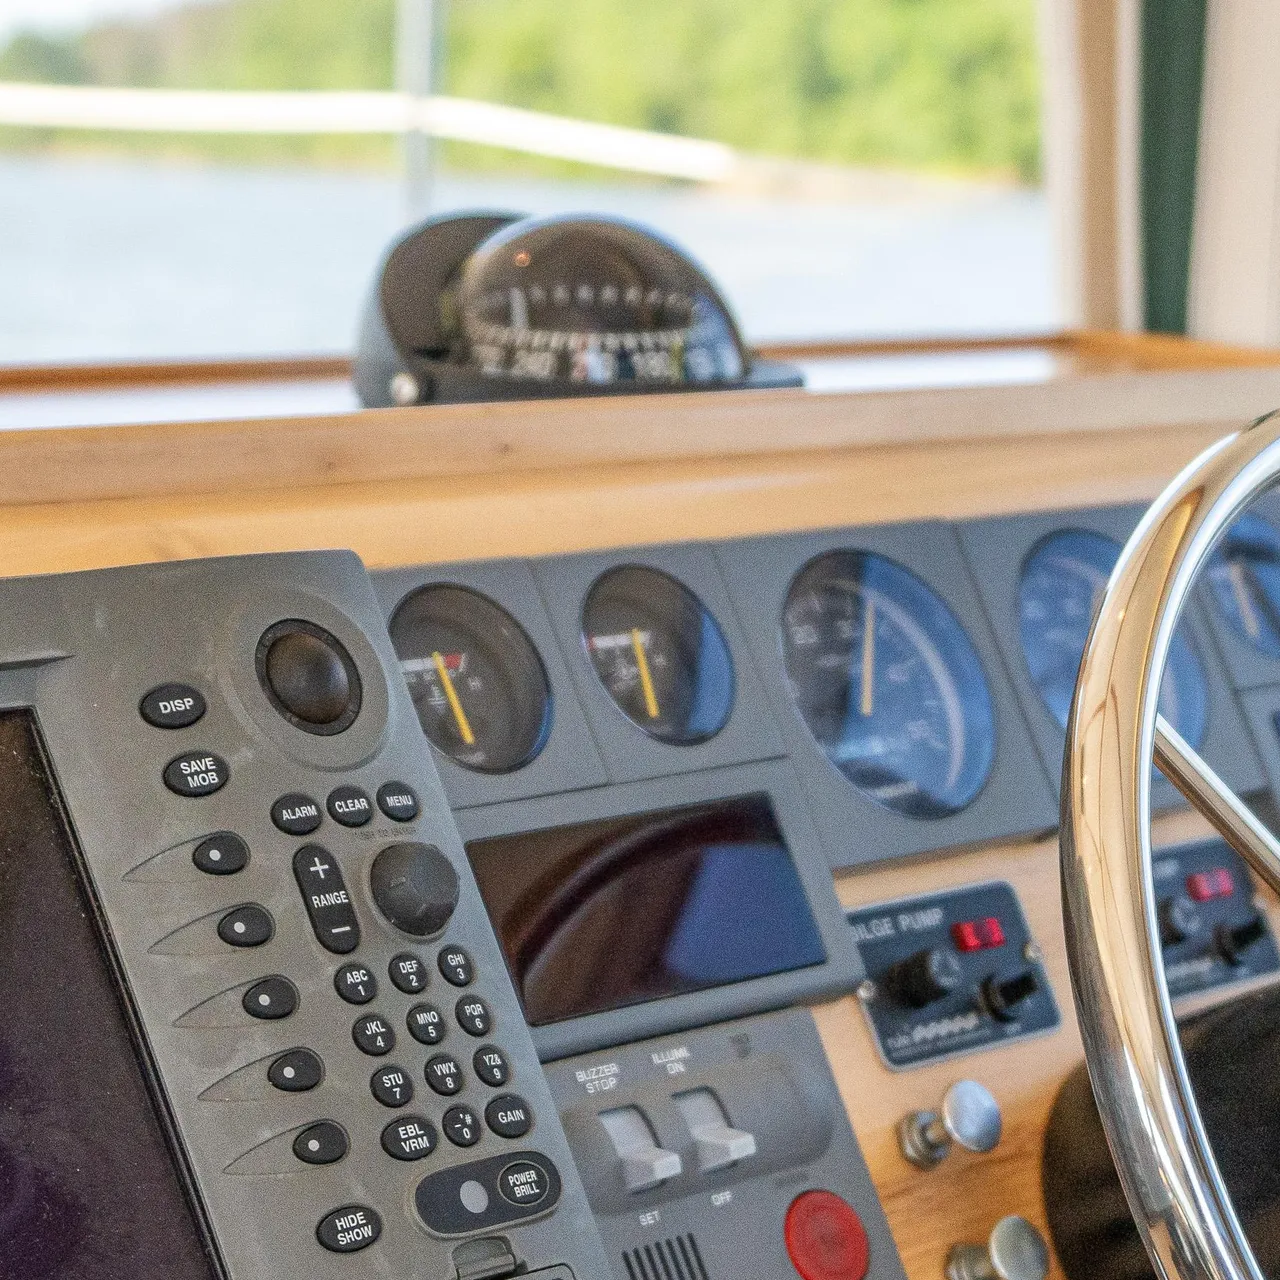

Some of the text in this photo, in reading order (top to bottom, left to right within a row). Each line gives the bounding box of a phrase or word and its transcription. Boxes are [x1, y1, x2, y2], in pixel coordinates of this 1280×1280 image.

[158, 697, 195, 714] DISP
[179, 757, 216, 775] SAVE
[186, 771, 218, 788] MOB
[335, 798, 369, 813] CLEAR
[386, 794, 412, 807] MENU
[281, 804, 317, 821] ALARM
[311, 890, 349, 909] RANGE
[854, 907, 944, 940] ILGE PUMP
[399, 959, 419, 974] DEF
[447, 953, 464, 966] GHI
[346, 968, 368, 984] ABC
[410, 974, 418, 986] 2
[456, 967, 464, 979] 3
[357, 985, 365, 996] 1
[464, 1003, 483, 1017] PQR
[416, 1011, 438, 1025] MNO
[475, 1017, 483, 1029] 6
[365, 1021, 386, 1035] JKL
[428, 1025, 436, 1037] 5
[376, 1035, 385, 1047] 4
[483, 1053, 501, 1067] YZ&
[666, 1061, 686, 1074] ON
[434, 1062, 456, 1076] VWX
[493, 1068, 501, 1080] 9
[575, 1063, 619, 1083] BUZZER
[382, 1072, 403, 1088] STU
[446, 1076, 454, 1089] 8
[586, 1077, 617, 1093] STOP
[393, 1088, 401, 1099] 7
[498, 1109, 524, 1123] GAIN
[398, 1123, 424, 1138] EBL
[463, 1128, 471, 1140] 0
[401, 1136, 429, 1153] VRM
[508, 1170, 537, 1186] POWER
[514, 1182, 540, 1197] BRILL
[710, 1191, 733, 1206] OFF
[335, 1212, 366, 1231] HIDE
[638, 1210, 661, 1226] SET
[337, 1225, 373, 1245] SHOW
